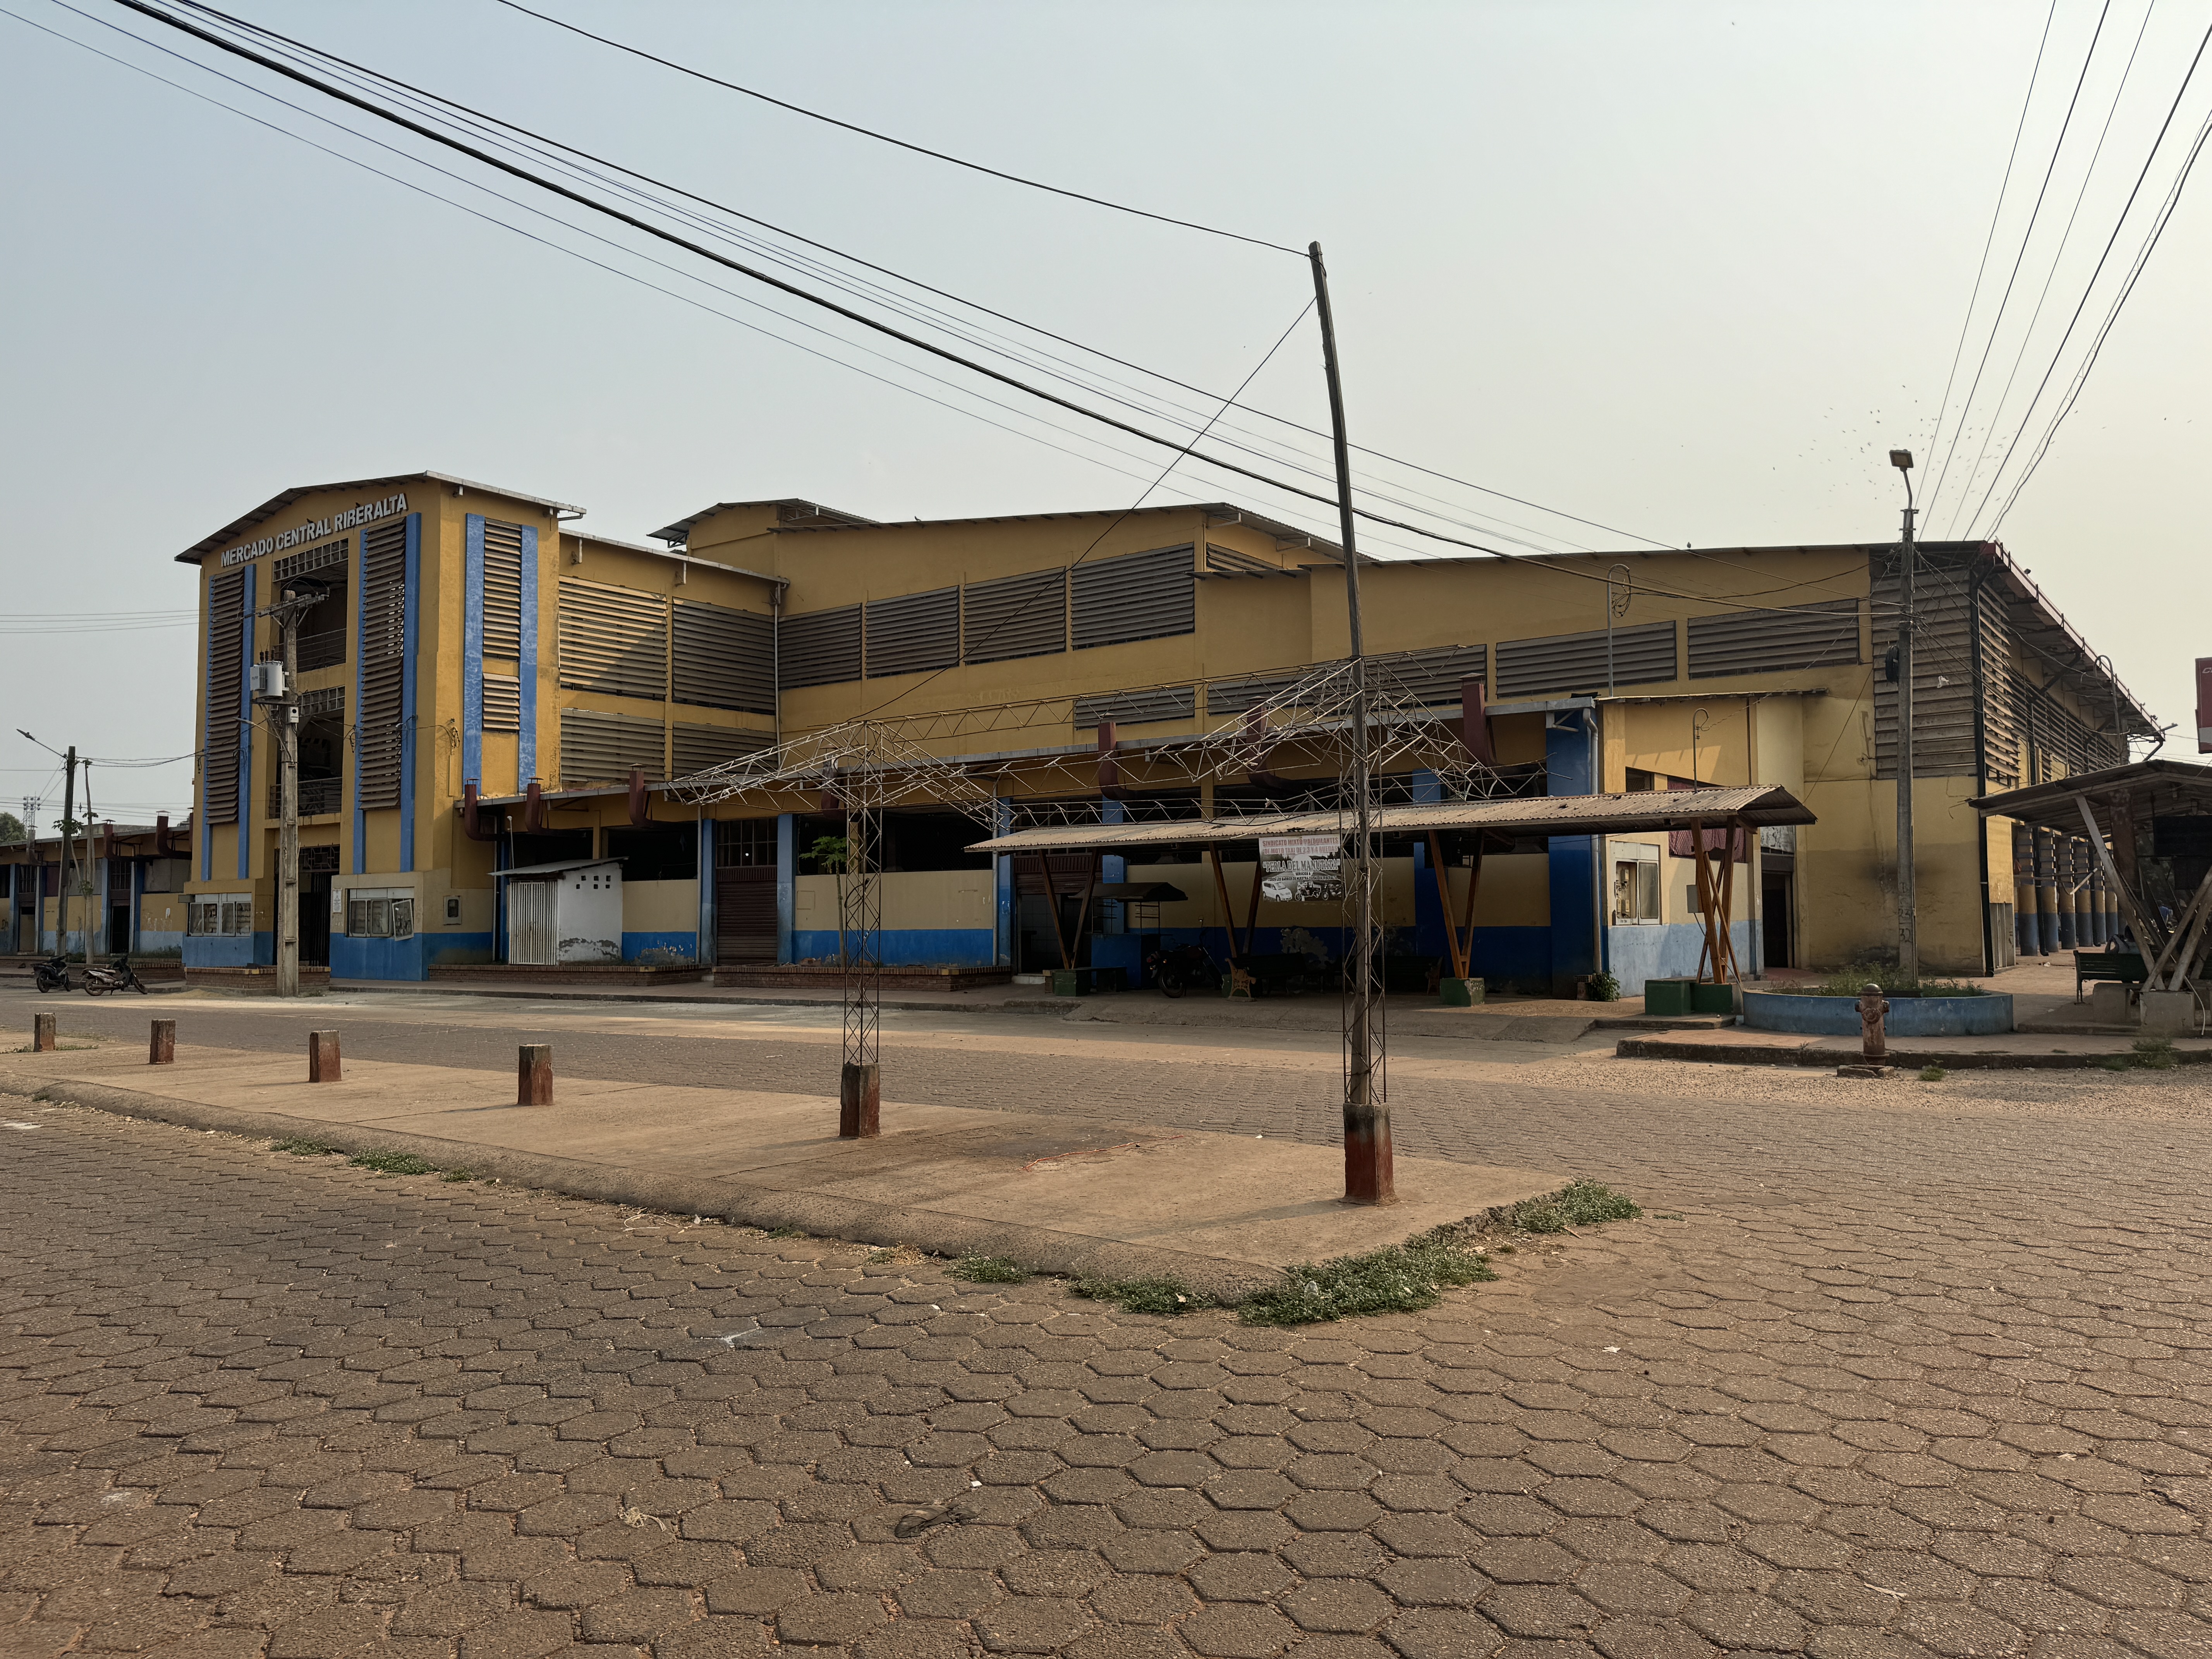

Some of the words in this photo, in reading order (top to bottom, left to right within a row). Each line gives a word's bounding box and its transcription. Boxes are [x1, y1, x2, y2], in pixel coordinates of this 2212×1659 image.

[221, 537, 274, 567] MERCADO
[276, 518, 331, 550] CENTRAL
[335, 493, 408, 532] RIBERALTA
[1287, 860, 1300, 871] DEL
